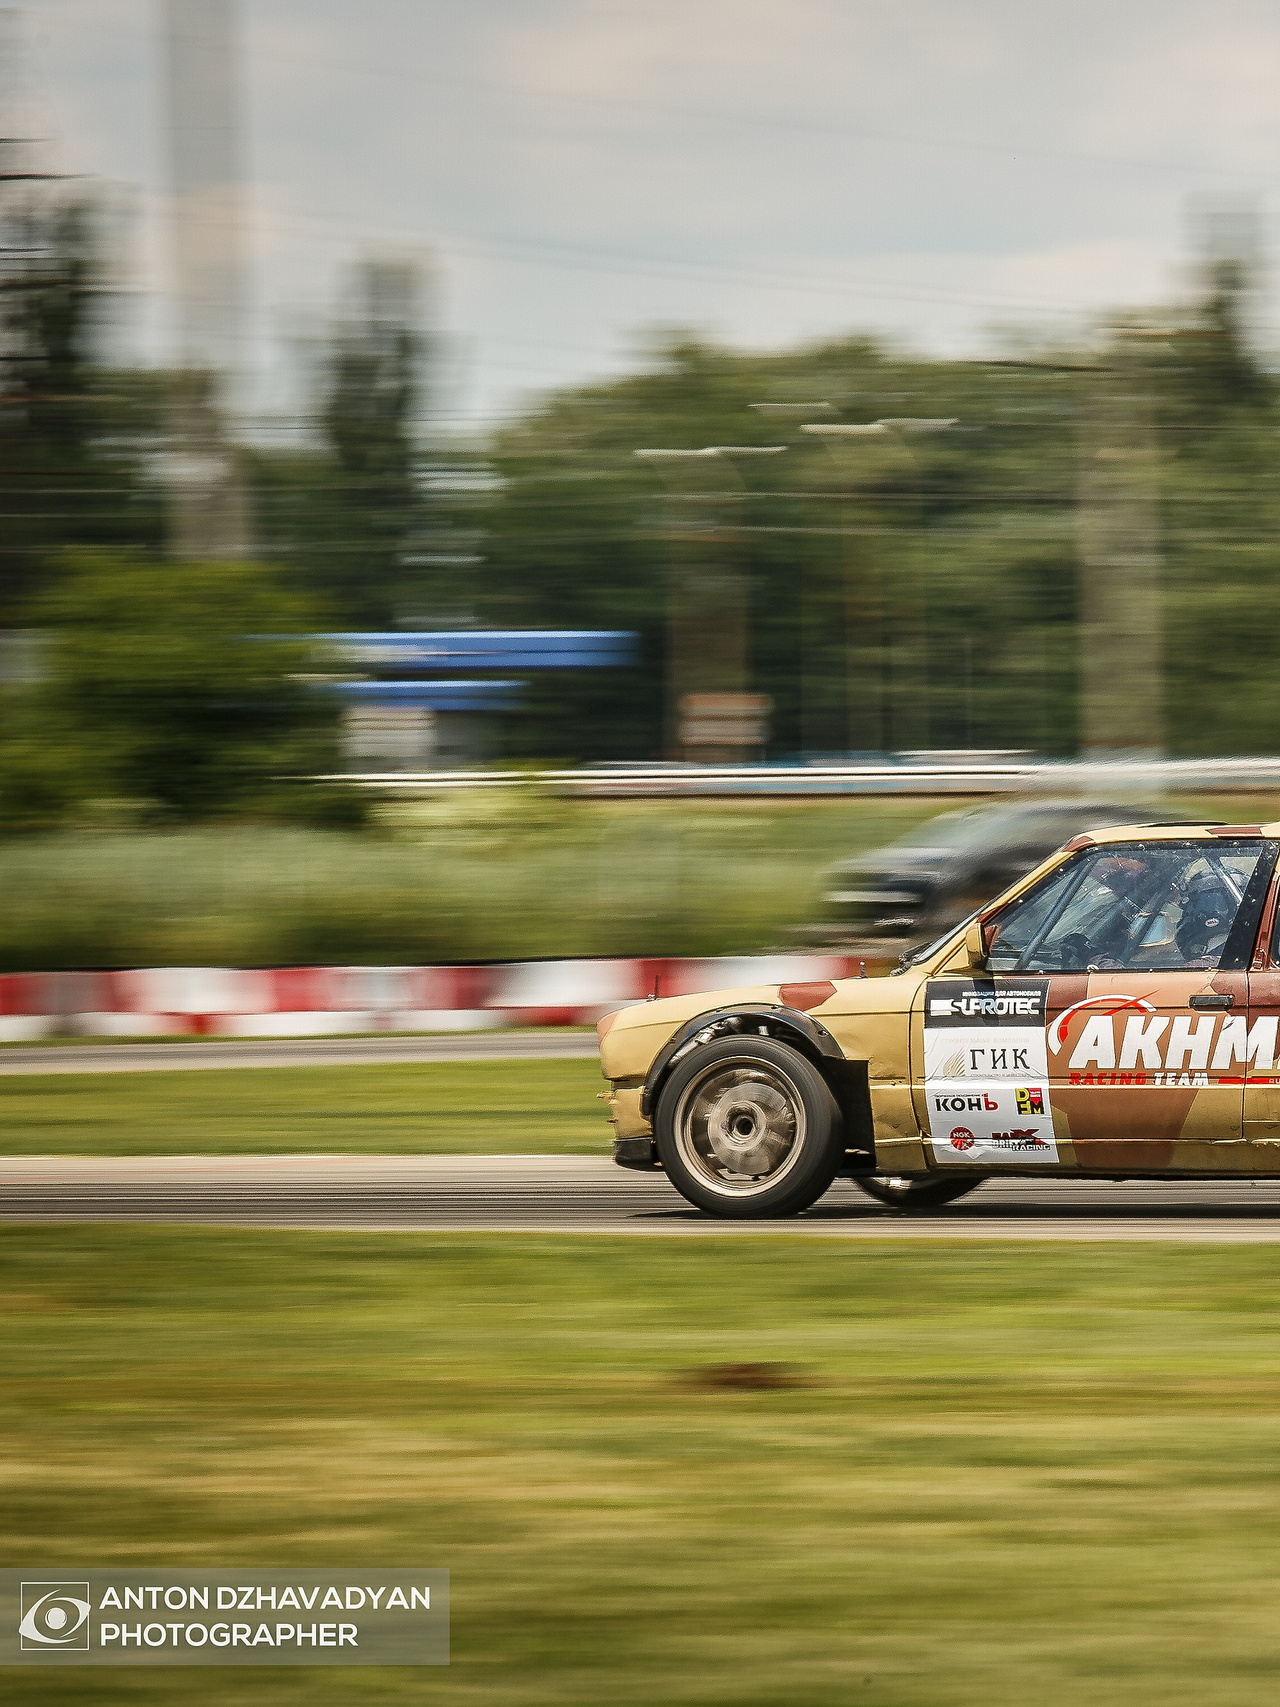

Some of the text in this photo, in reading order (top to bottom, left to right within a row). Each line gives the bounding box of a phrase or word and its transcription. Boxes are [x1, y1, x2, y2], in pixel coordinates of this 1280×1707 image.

[945, 998, 1041, 1016] SUPROTEC
[969, 1048, 1031, 1070] ГИК
[1069, 1072, 1209, 1086] RACING TEAM
